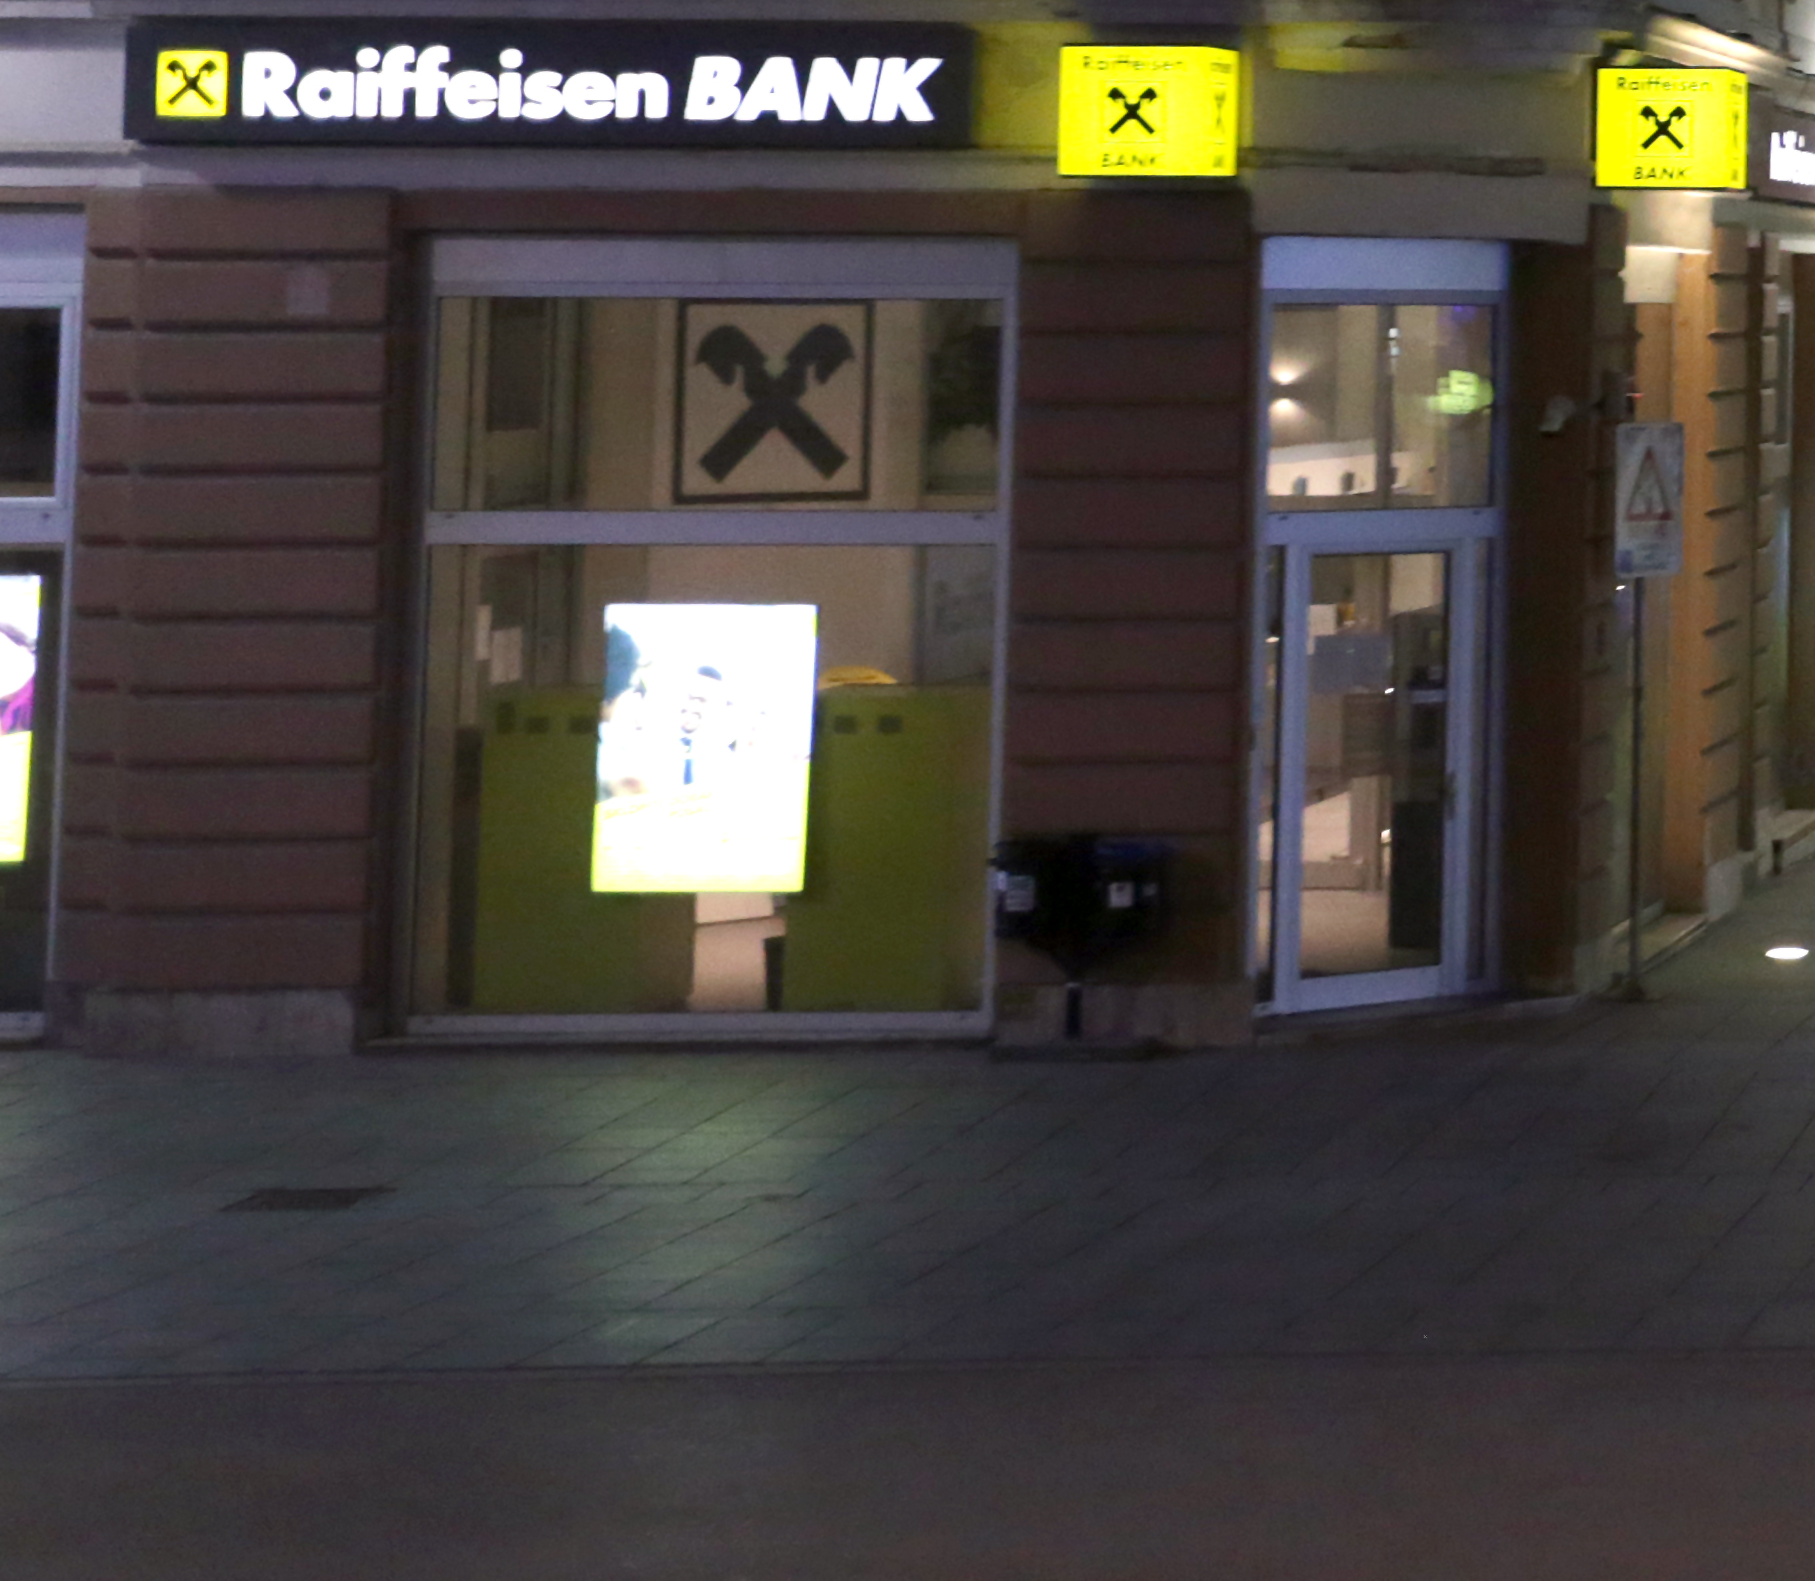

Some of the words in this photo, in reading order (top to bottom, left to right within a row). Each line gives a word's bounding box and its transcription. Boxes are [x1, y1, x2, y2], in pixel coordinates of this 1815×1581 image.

[241, 44, 669, 121] Raiffeisen
[683, 55, 943, 122] BANK
[1616, 76, 1711, 92] Raiffeisen
[1101, 153, 1158, 168] BANK
[1633, 166, 1688, 181] BANK
